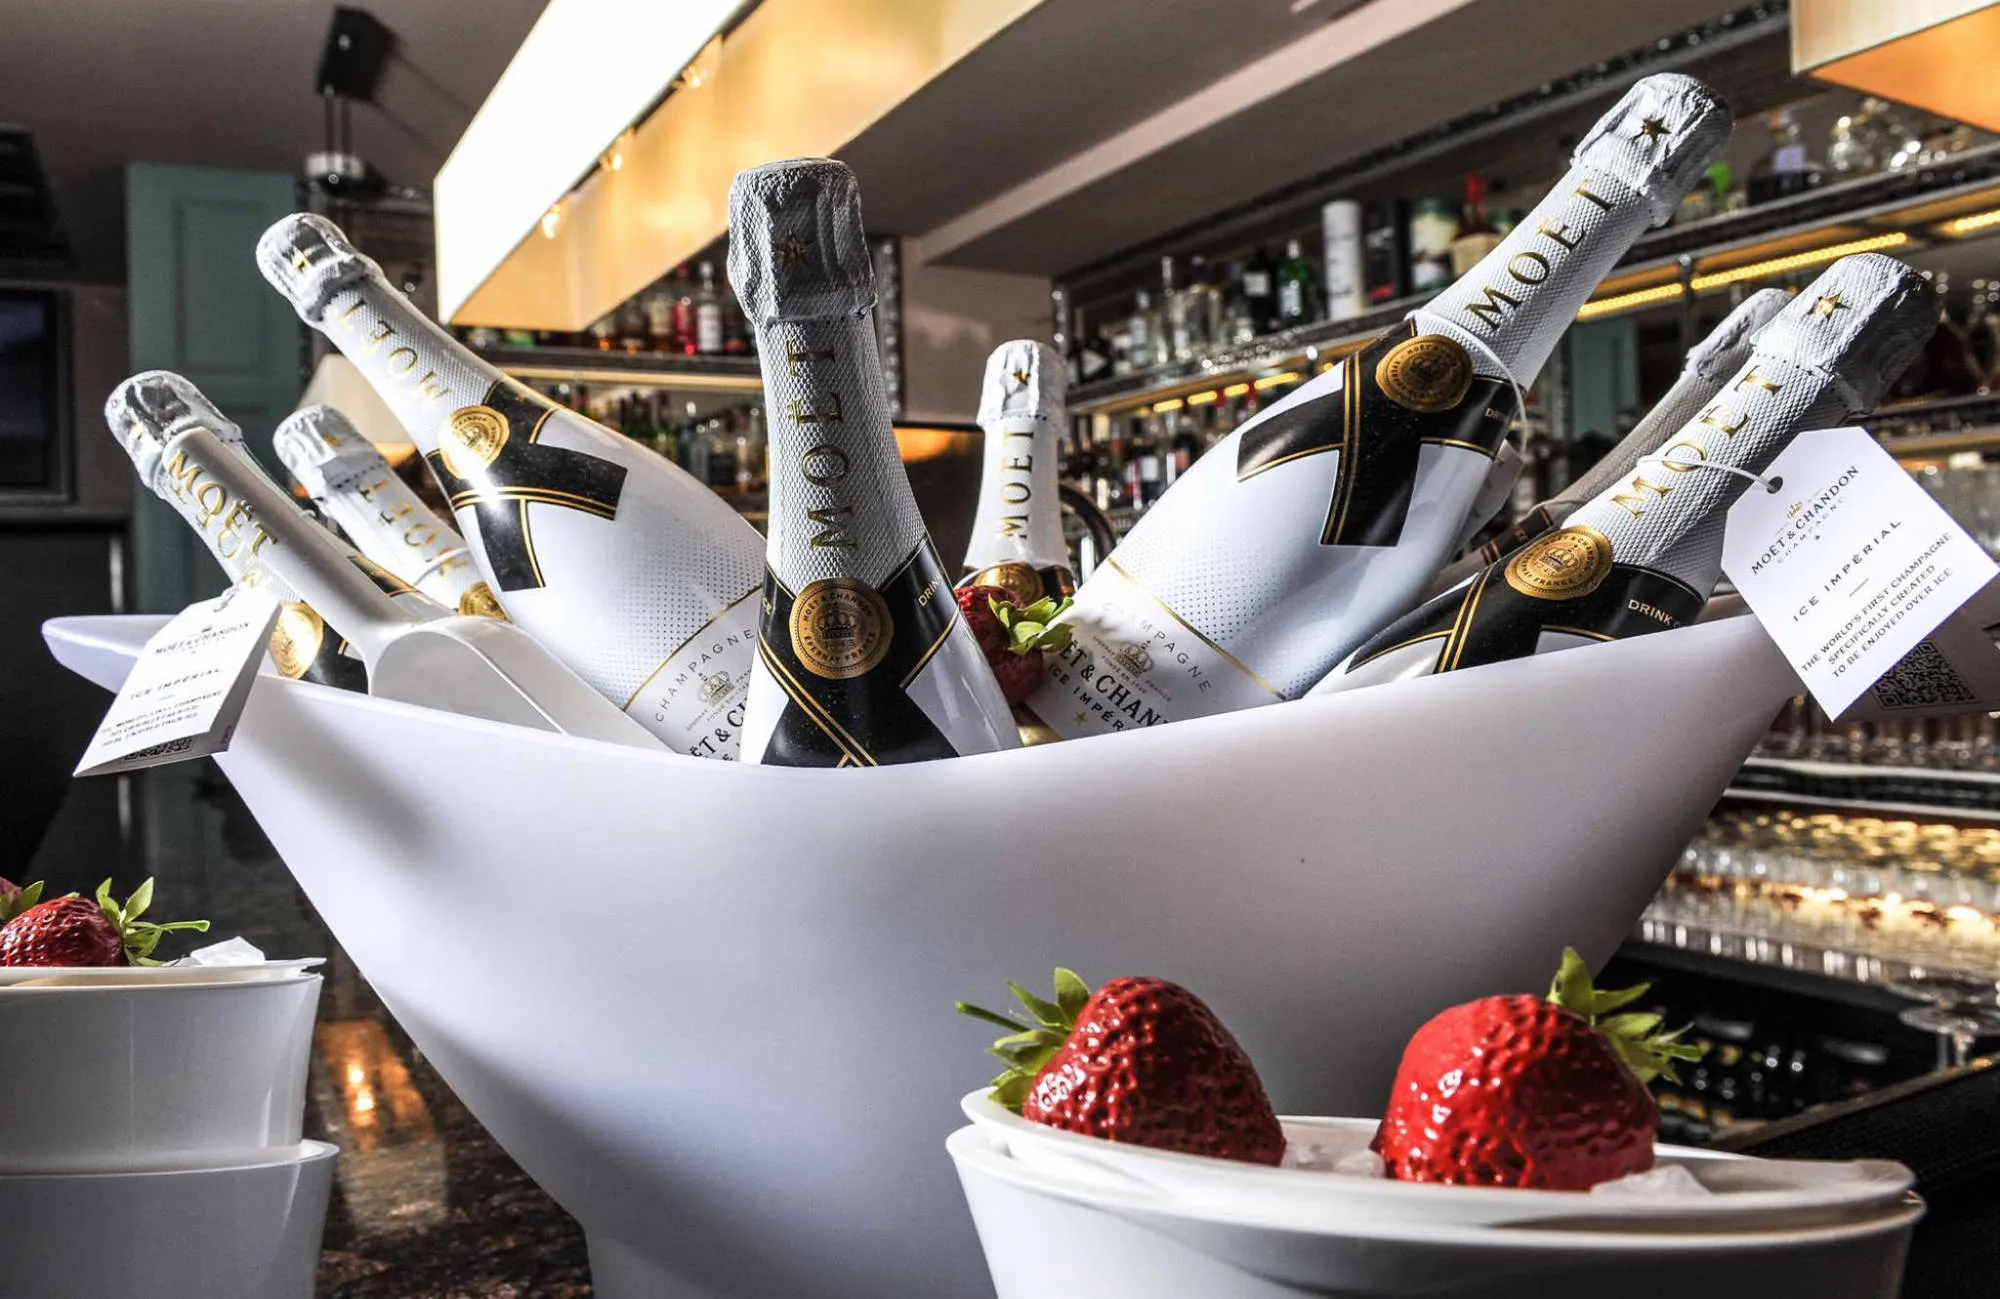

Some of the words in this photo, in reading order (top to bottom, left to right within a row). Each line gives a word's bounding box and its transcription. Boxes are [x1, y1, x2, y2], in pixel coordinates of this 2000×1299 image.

[1786, 530, 1796, 540] &
[1795, 465, 1860, 530] CHANDON
[1628, 598, 1673, 626] DRINK
[1792, 595, 1820, 623] ICE
[1801, 654, 1821, 672] THE
[1862, 587, 1890, 616] FIRST
[1890, 531, 1953, 588] CHAMPAGNE
[1827, 605, 1891, 665] SPECIFICALLY
[1890, 564, 1936, 607] CREATED
[1832, 664, 1847, 678] TO
[1848, 652, 1862, 665] BE
[1861, 610, 1905, 653] ENJOYED
[1905, 585, 1934, 611] OVER
[1933, 567, 1954, 586] ICE
[655, 629, 755, 722] CHAMPAGNE
[1059, 640, 1088, 668] ËT
[1080, 663, 1095, 682] &
[1095, 674, 1169, 727] CHAN
[1102, 602, 1212, 693] CMPAGNE
[1049, 664, 1071, 686] ICE
[1072, 686, 1125, 732] IMPÉR
[690, 735, 717, 759] ËT
[714, 728, 733, 743] &
